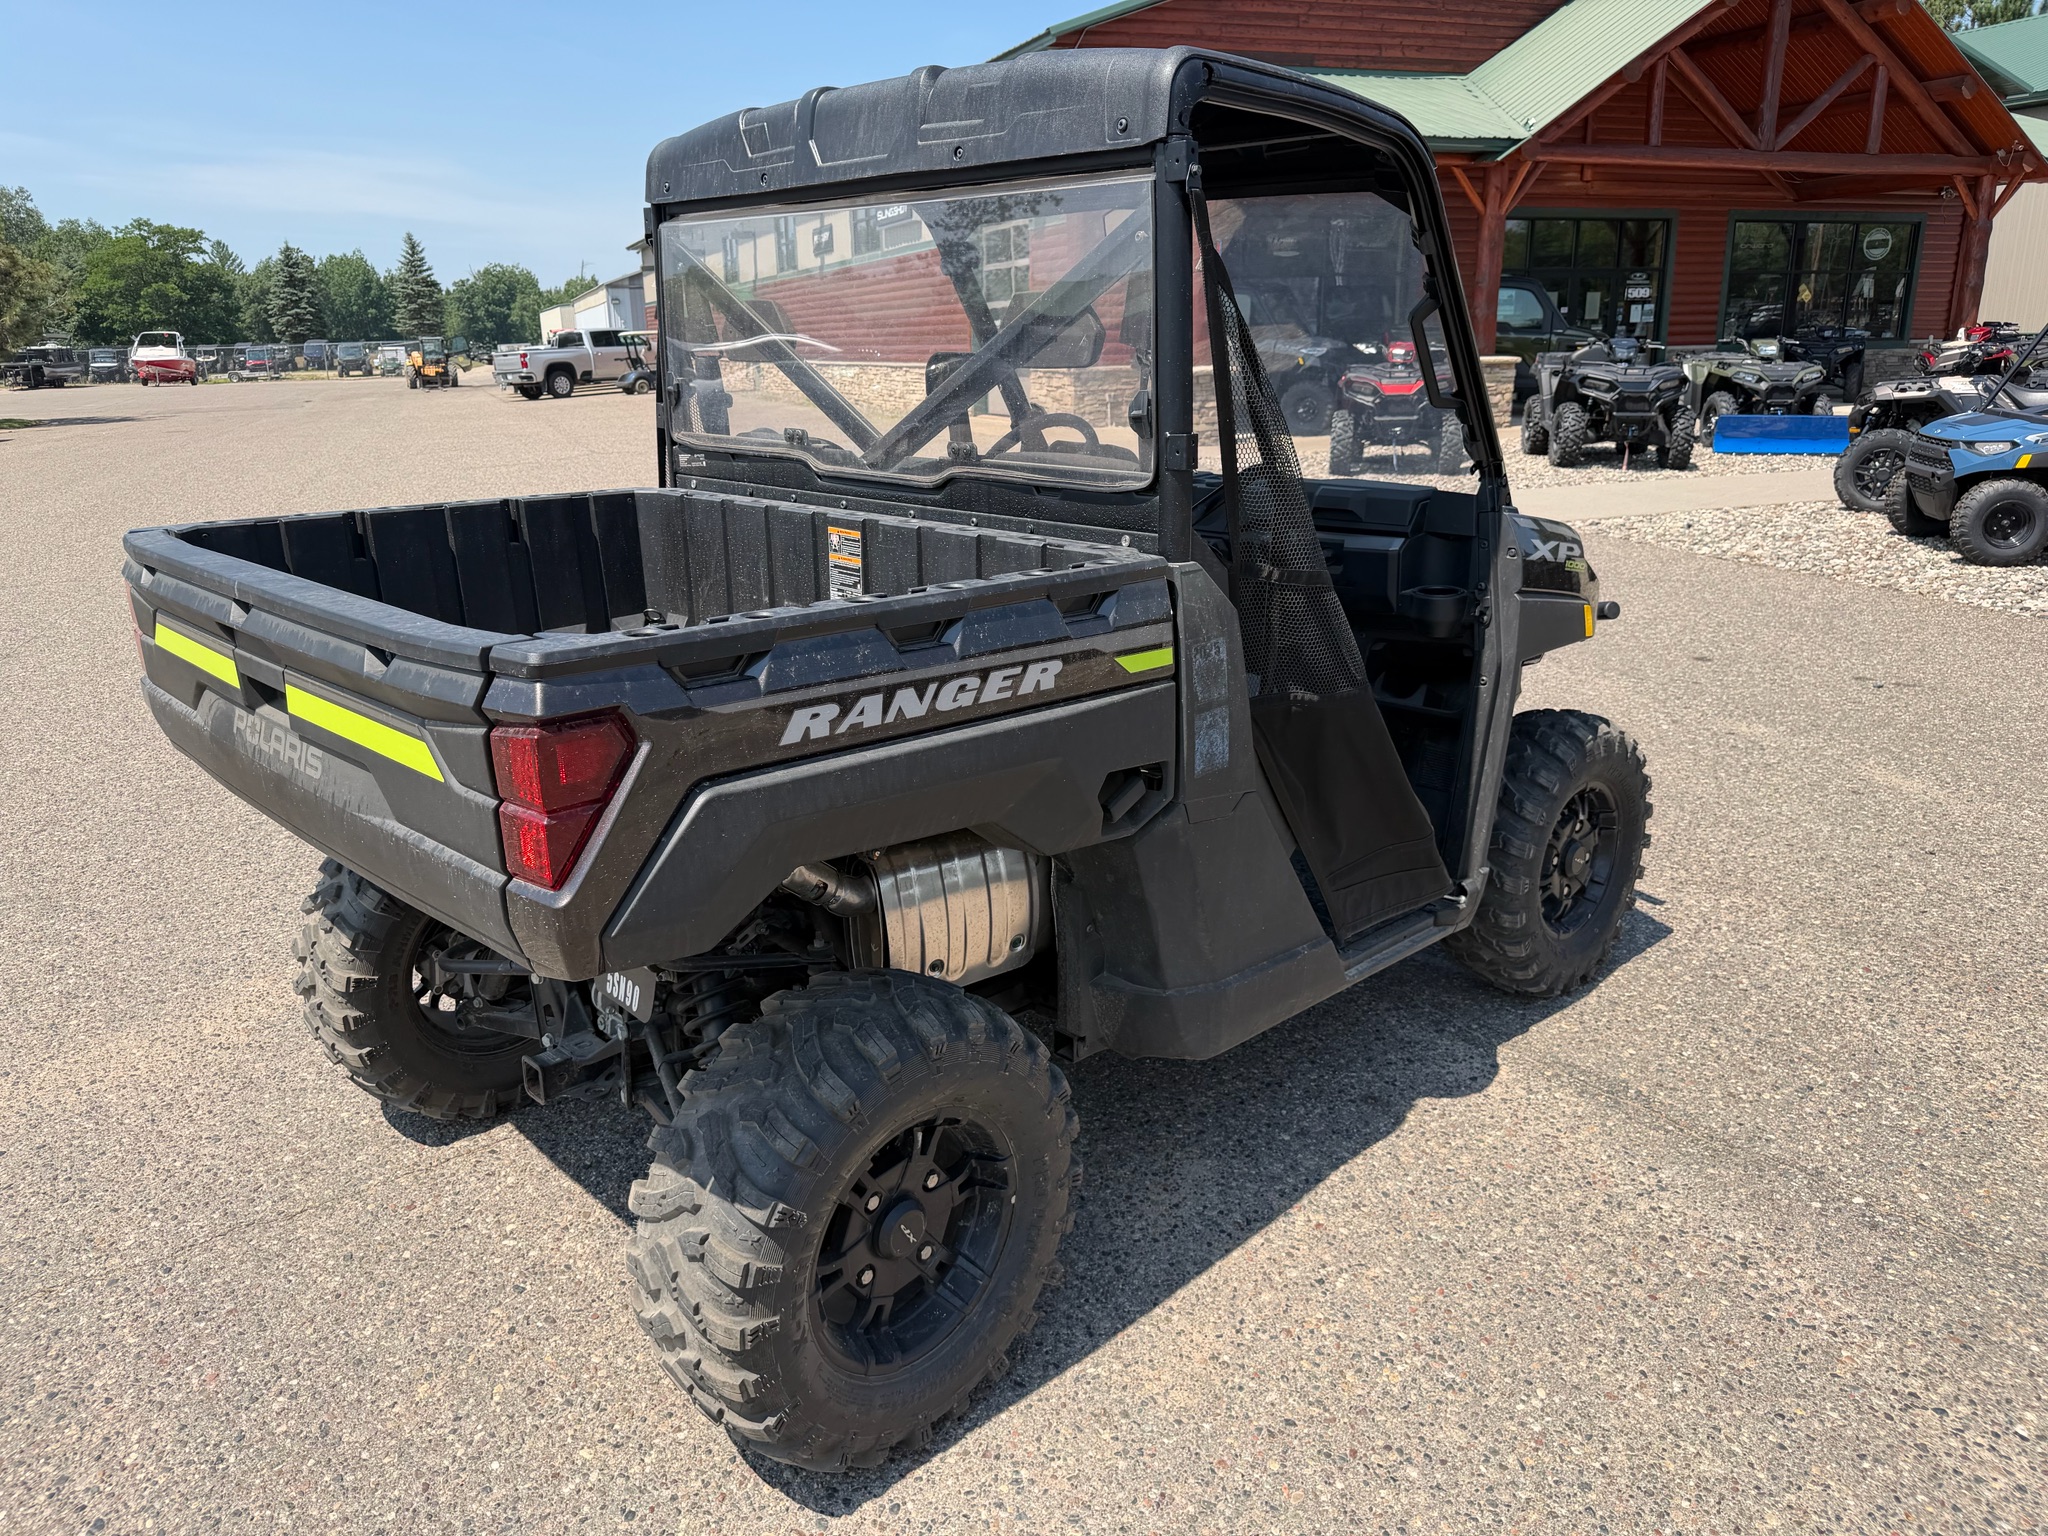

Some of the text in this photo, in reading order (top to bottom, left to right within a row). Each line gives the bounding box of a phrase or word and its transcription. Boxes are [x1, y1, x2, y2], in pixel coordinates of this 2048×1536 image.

[1627, 287, 1650, 299] 509
[1525, 538, 1581, 563] XP
[1565, 560, 1585, 570] 1000
[779, 660, 1063, 746] RANGER
[233, 707, 323, 780] POLARIS
